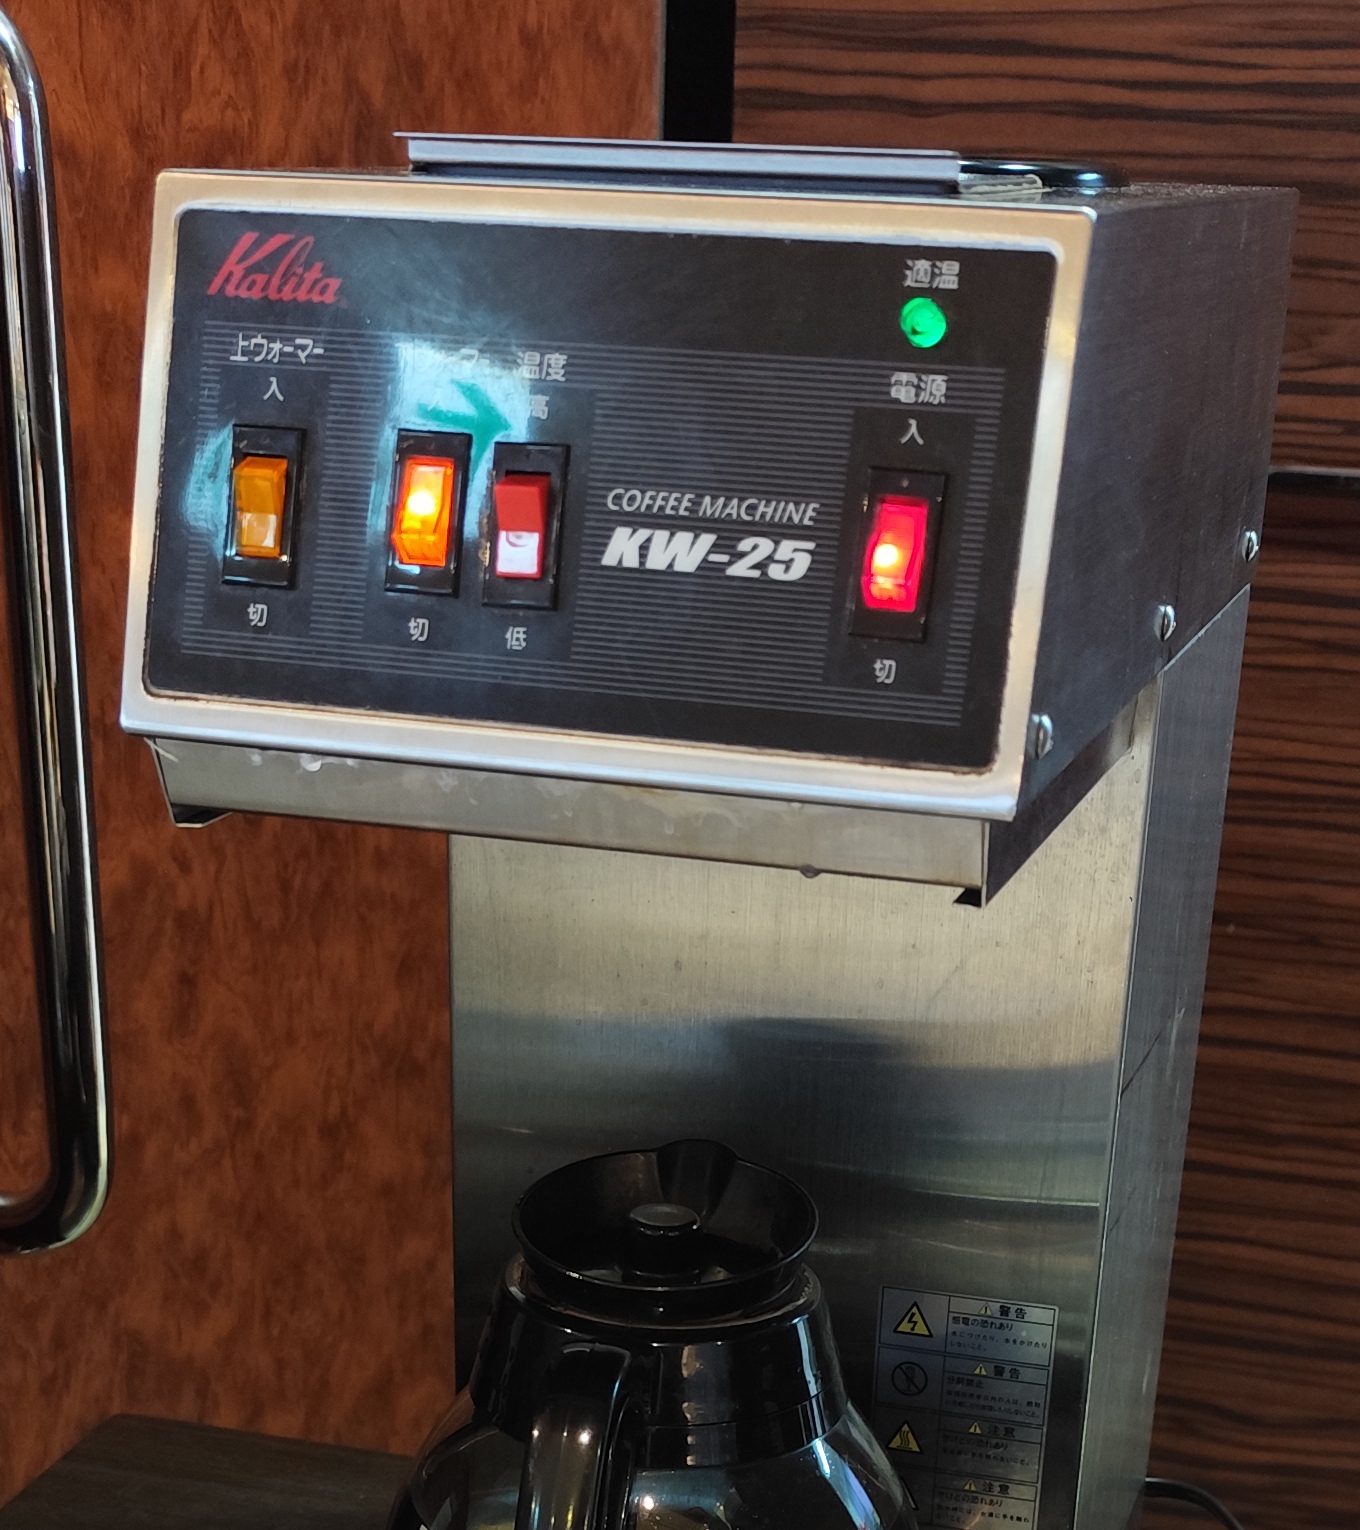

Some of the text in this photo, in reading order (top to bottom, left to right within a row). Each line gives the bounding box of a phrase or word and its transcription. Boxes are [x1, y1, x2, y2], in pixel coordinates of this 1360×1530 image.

[207, 231, 343, 305] Kalita
[903, 258, 960, 290] 適温
[230, 332, 325, 364] 上ウォーマー
[517, 351, 568, 382] 温度
[263, 377, 285, 401] 入
[889, 372, 949, 405] 電源
[899, 418, 925, 446] 入
[607, 488, 820, 526] COFFEE MACHINE
[601, 526, 816, 582] KW-25
[247, 604, 268, 627] 切
[408, 618, 429, 642] 切
[505, 627, 527, 650] 低
[873, 658, 897, 685] 切
